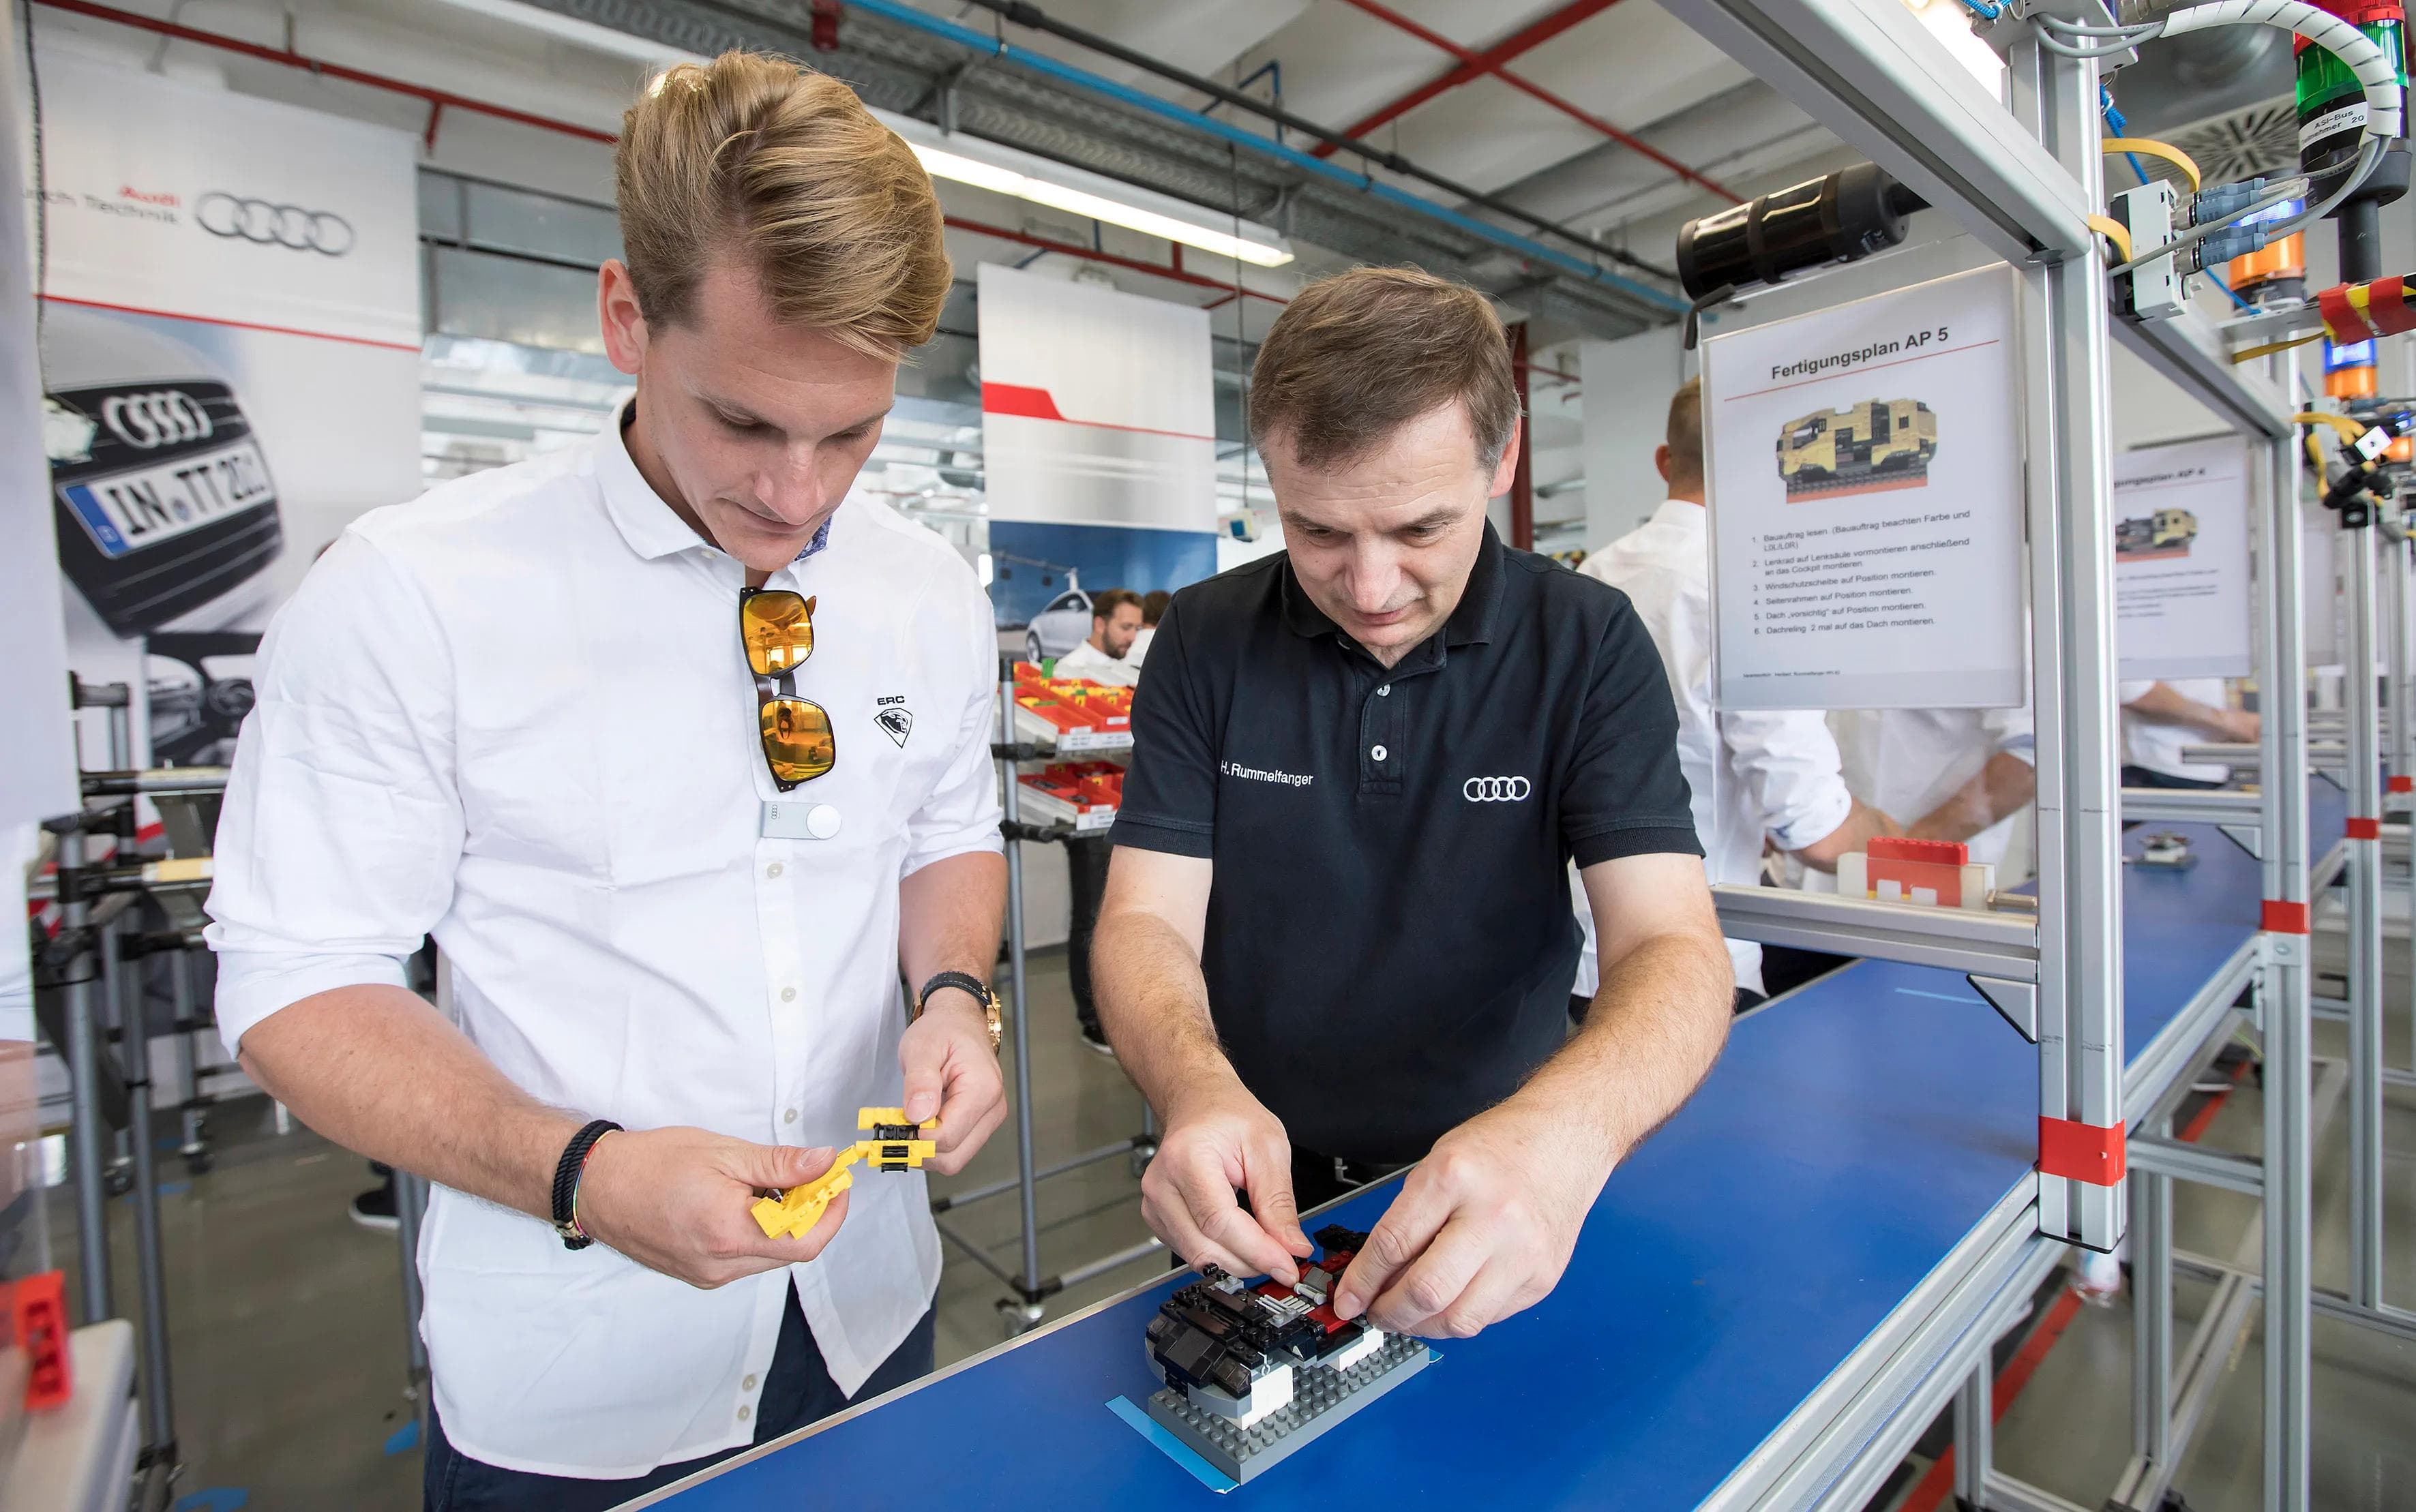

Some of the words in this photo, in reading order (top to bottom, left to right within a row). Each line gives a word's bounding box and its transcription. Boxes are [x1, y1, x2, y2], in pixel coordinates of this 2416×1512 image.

[2314, 111, 2353, 129] ASI-Bus
[2351, 115, 2364, 123] 20
[1771, 341, 1899, 380] Fertigungsplan
[1905, 331, 1932, 349] AP
[1937, 327, 1949, 342] 5
[106, 479, 175, 536] IN
[175, 465, 226, 515] TT
[1763, 532, 1804, 542] Bauauftrag
[1882, 516, 1922, 528] beachten
[1924, 513, 1950, 523] Farbe
[1953, 510, 1971, 519] und
[1765, 556, 1795, 566] Lenkrad
[1797, 554, 1809, 563] auf
[1811, 551, 1851, 562] Lenksäule
[1853, 545, 1908, 557] vormontieren
[1910, 537, 1970, 551] anschließend
[1776, 566, 1790, 575] das
[1792, 564, 1820, 574] Cockpit
[1765, 578, 1838, 590] Windschutzscheibe
[1840, 575, 1853, 584] auf
[1855, 573, 1888, 582] Position
[1766, 595, 1818, 605] Seitenrahmen
[1835, 591, 1867, 599] Position
[1766, 611, 1786, 620] Dach
[1847, 605, 1879, 614] Position
[1766, 626, 1806, 634] Dachreling
[1818, 622, 1832, 631] mal
[1834, 622, 1847, 630] auf
[1849, 621, 1864, 629] das
[877, 695, 905, 706] ERC
[1221, 759, 1229, 775] H.
[1231, 763, 1313, 787] Rummelfanger
